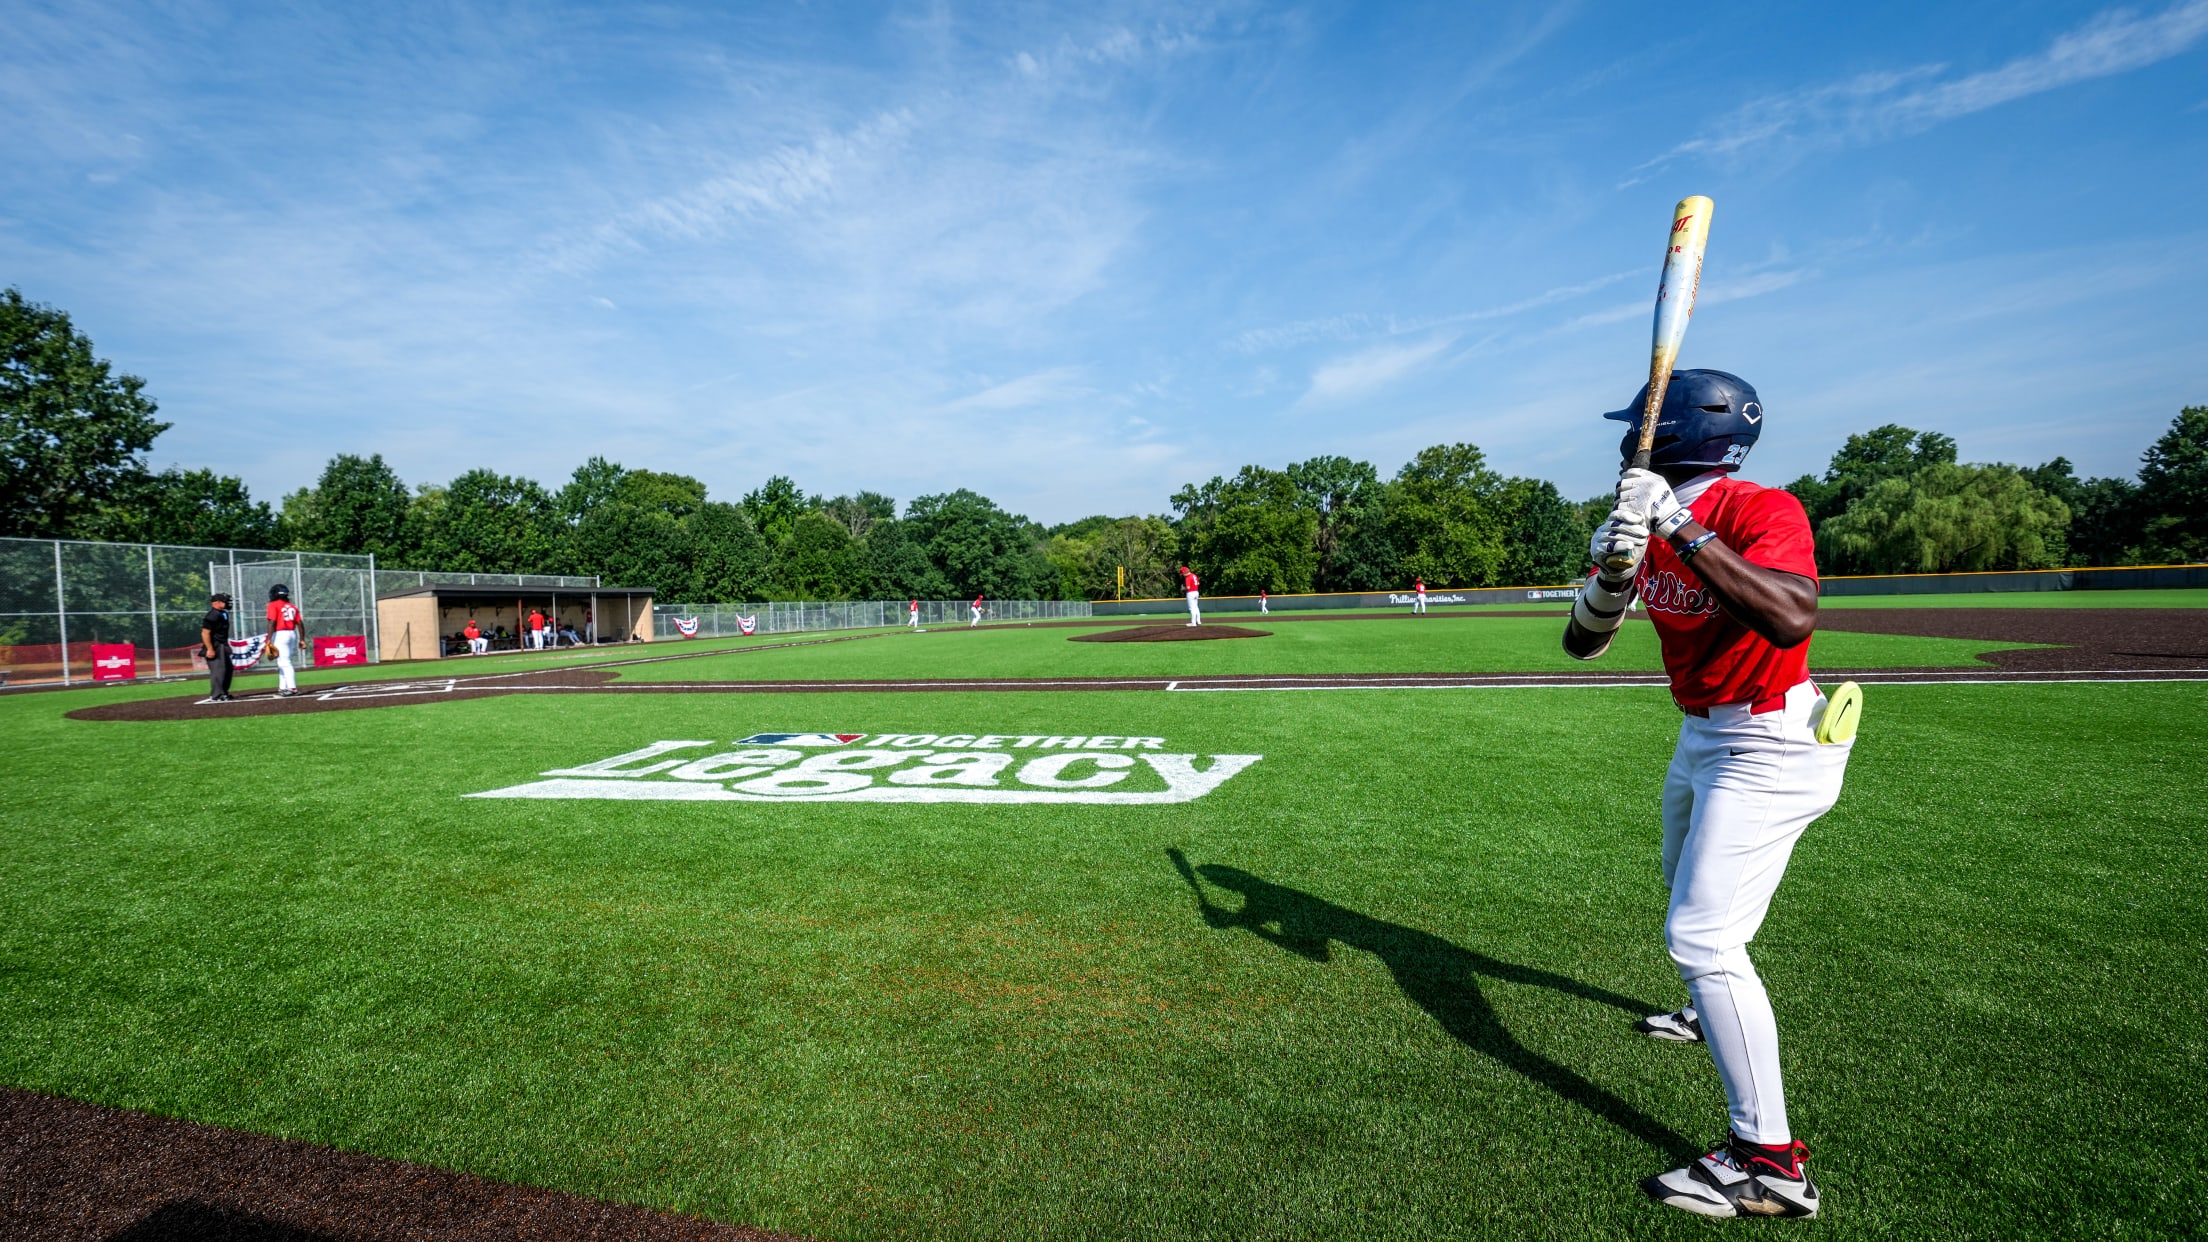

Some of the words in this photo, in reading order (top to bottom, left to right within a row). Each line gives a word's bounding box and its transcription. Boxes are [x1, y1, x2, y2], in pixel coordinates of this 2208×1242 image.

[1722, 444, 1749, 464] 23
[1542, 589, 1575, 598] TOGETHER
[1634, 560, 1720, 614] hillies
[865, 734, 1166, 749] TOGETHER
[539, 741, 1263, 803] Legacy
